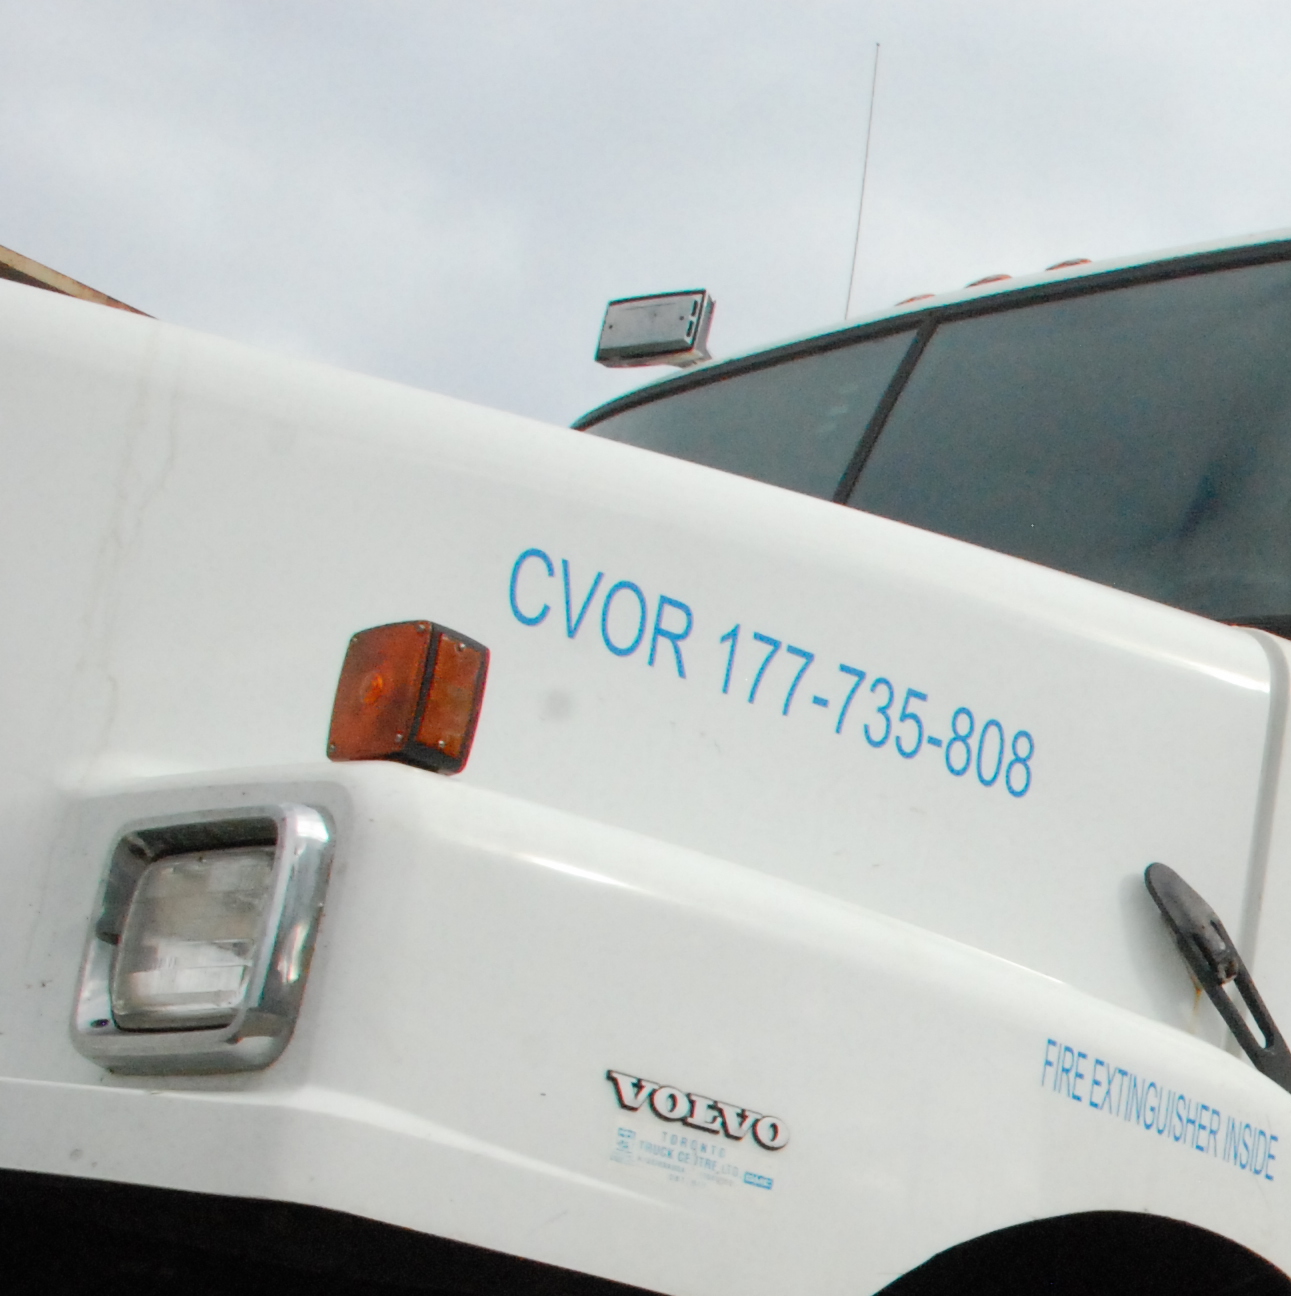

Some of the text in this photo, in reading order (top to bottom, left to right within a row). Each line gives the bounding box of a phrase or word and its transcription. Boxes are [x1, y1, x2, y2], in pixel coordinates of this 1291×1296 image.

[508, 546, 1035, 798] CVOR 177-735-808
[605, 1068, 790, 1151] VOLVO
[1041, 1037, 1279, 1181] FIRE EXTINGUISHER INSIDE
